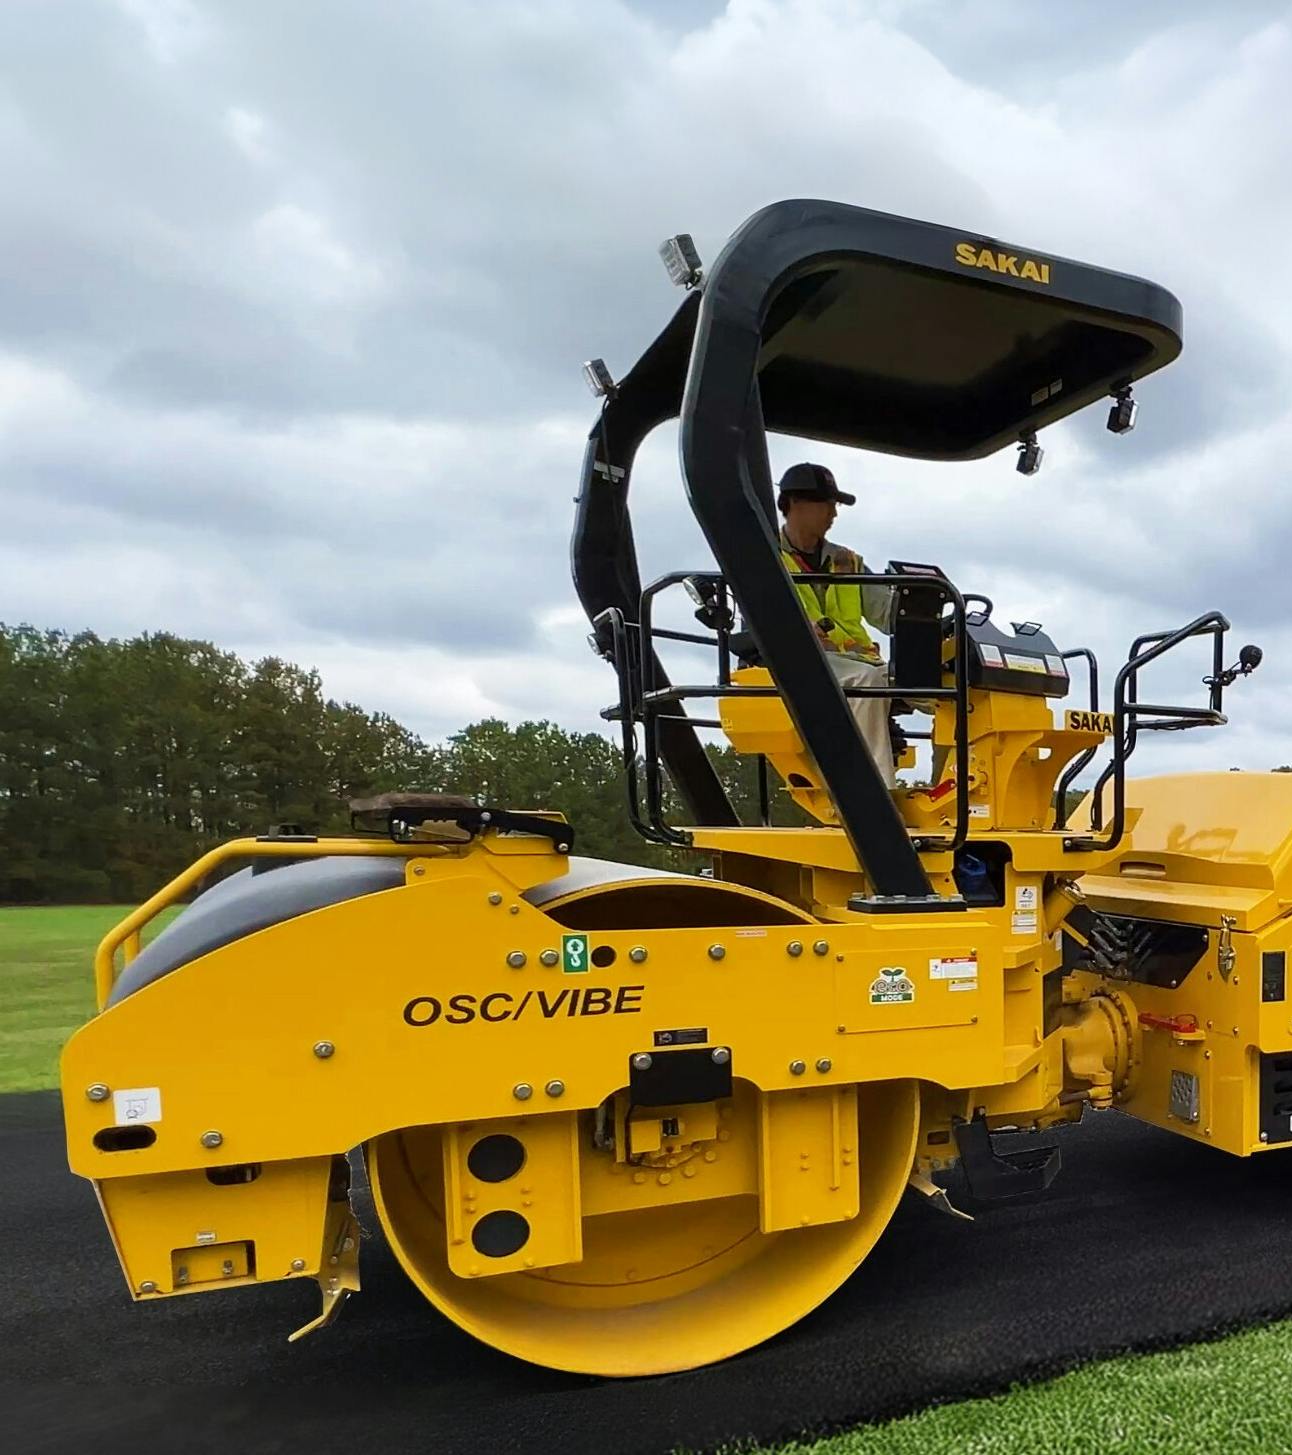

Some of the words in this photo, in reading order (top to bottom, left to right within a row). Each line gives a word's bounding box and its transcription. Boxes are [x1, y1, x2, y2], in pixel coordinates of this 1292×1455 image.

[955, 243, 1050, 285] SAKAI
[1070, 711, 1116, 733] SAKA
[403, 985, 645, 1027] OSC/VIBE
